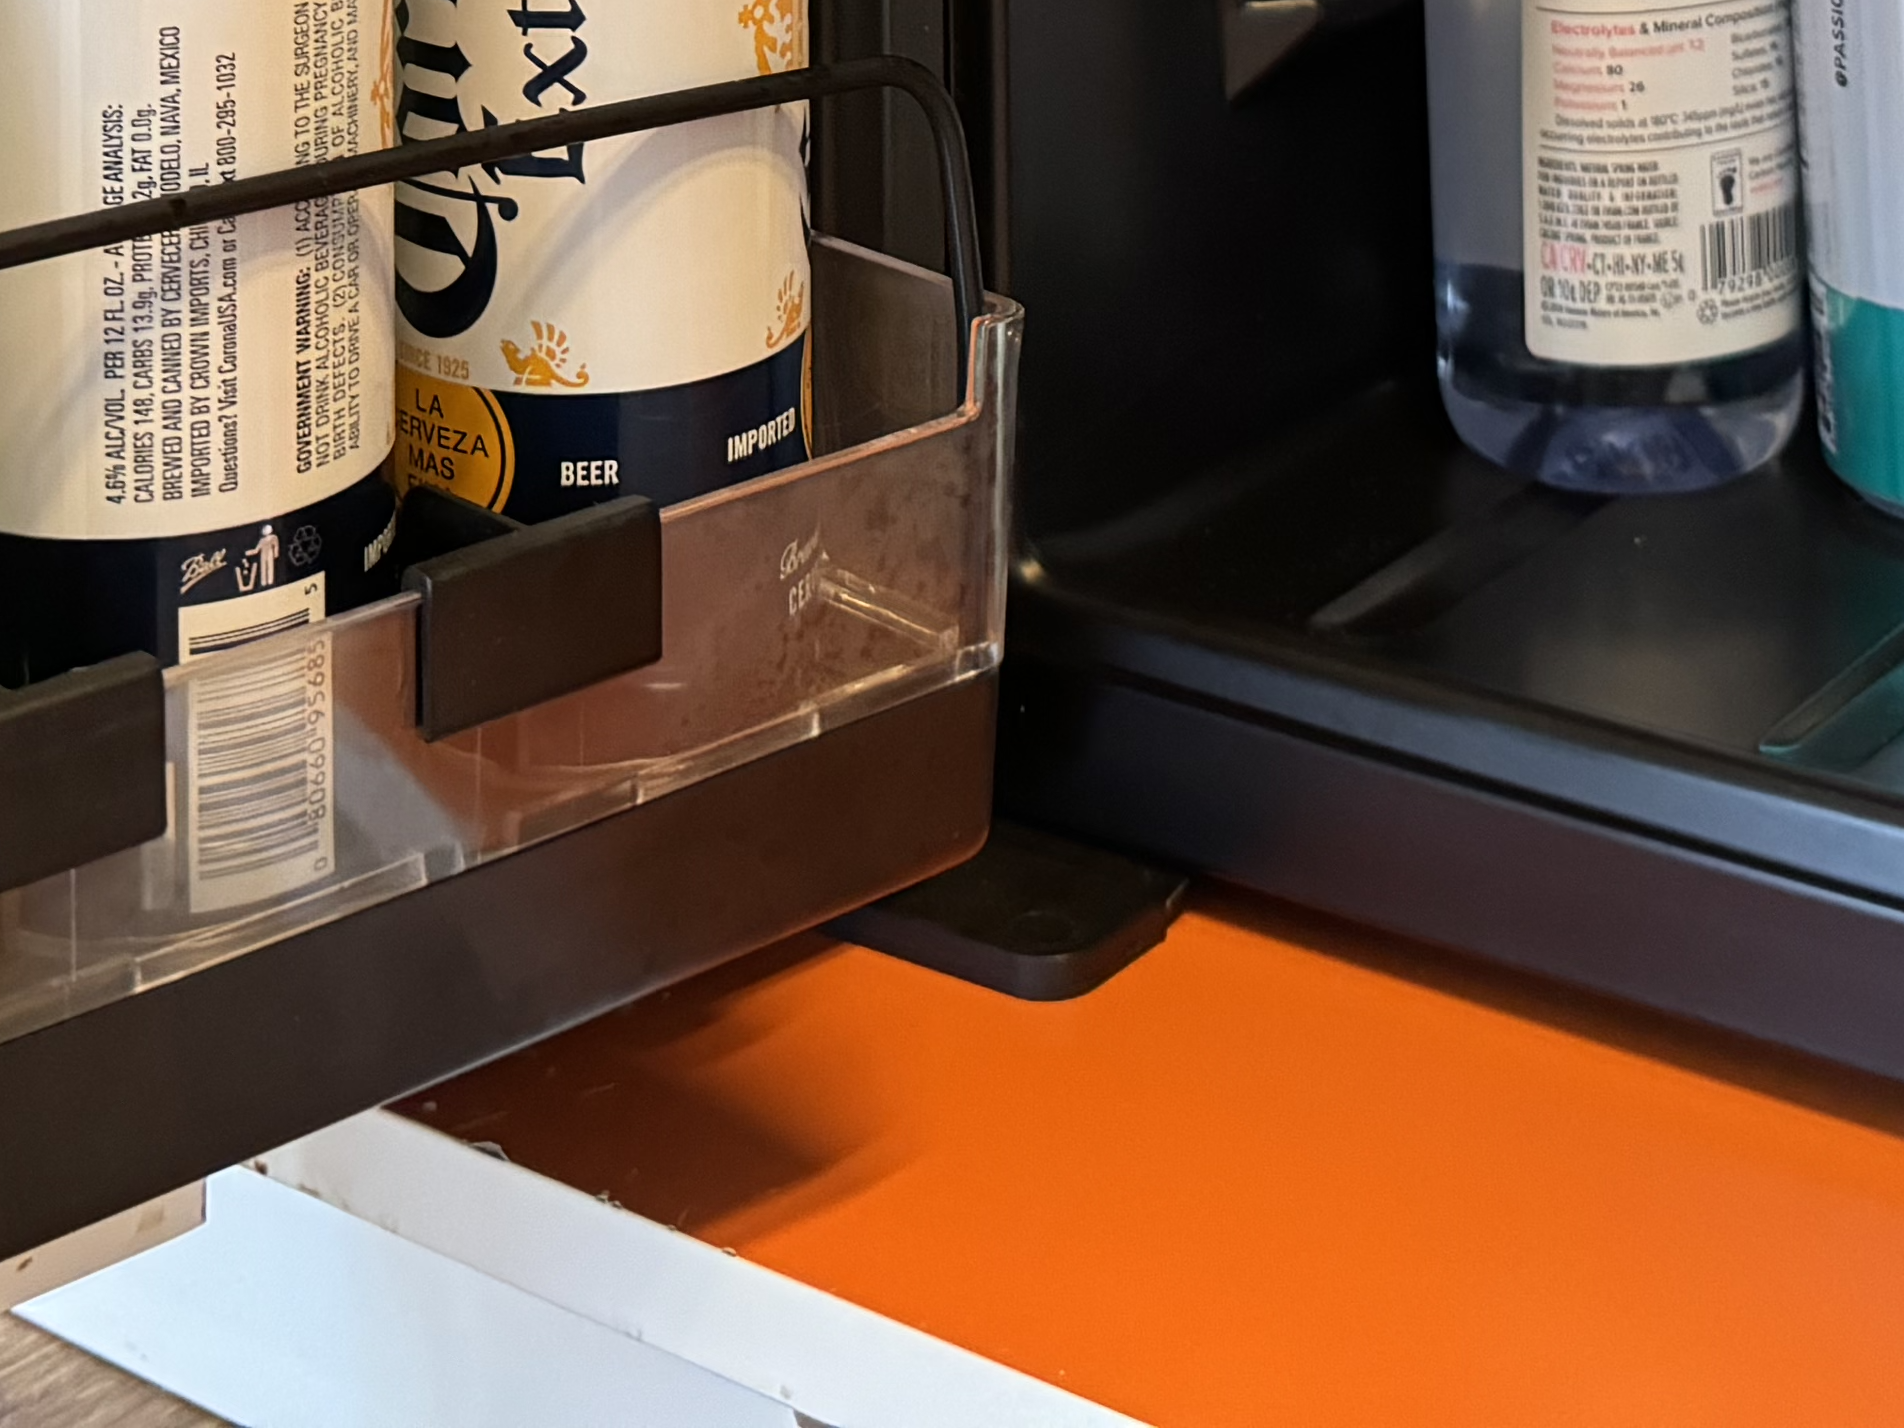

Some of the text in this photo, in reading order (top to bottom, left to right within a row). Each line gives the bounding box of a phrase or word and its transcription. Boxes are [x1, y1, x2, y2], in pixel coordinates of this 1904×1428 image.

[1653, 15, 1703, 34] Mineral
[158, 25, 181, 86] MEXICO
[215, 51, 237, 165] 800-295-1032
[216, 256, 238, 494] Questions? Visit CoronaUSA.com
[295, 266, 312, 474] GOVERNMENT WARNING:
[437, 355, 469, 380] 1925
[415, 388, 444, 419] LA
[399, 409, 489, 458] ERVEZA
[727, 407, 796, 463] IMPORTED
[409, 445, 455, 481] MAS
[560, 459, 620, 486] BEER
